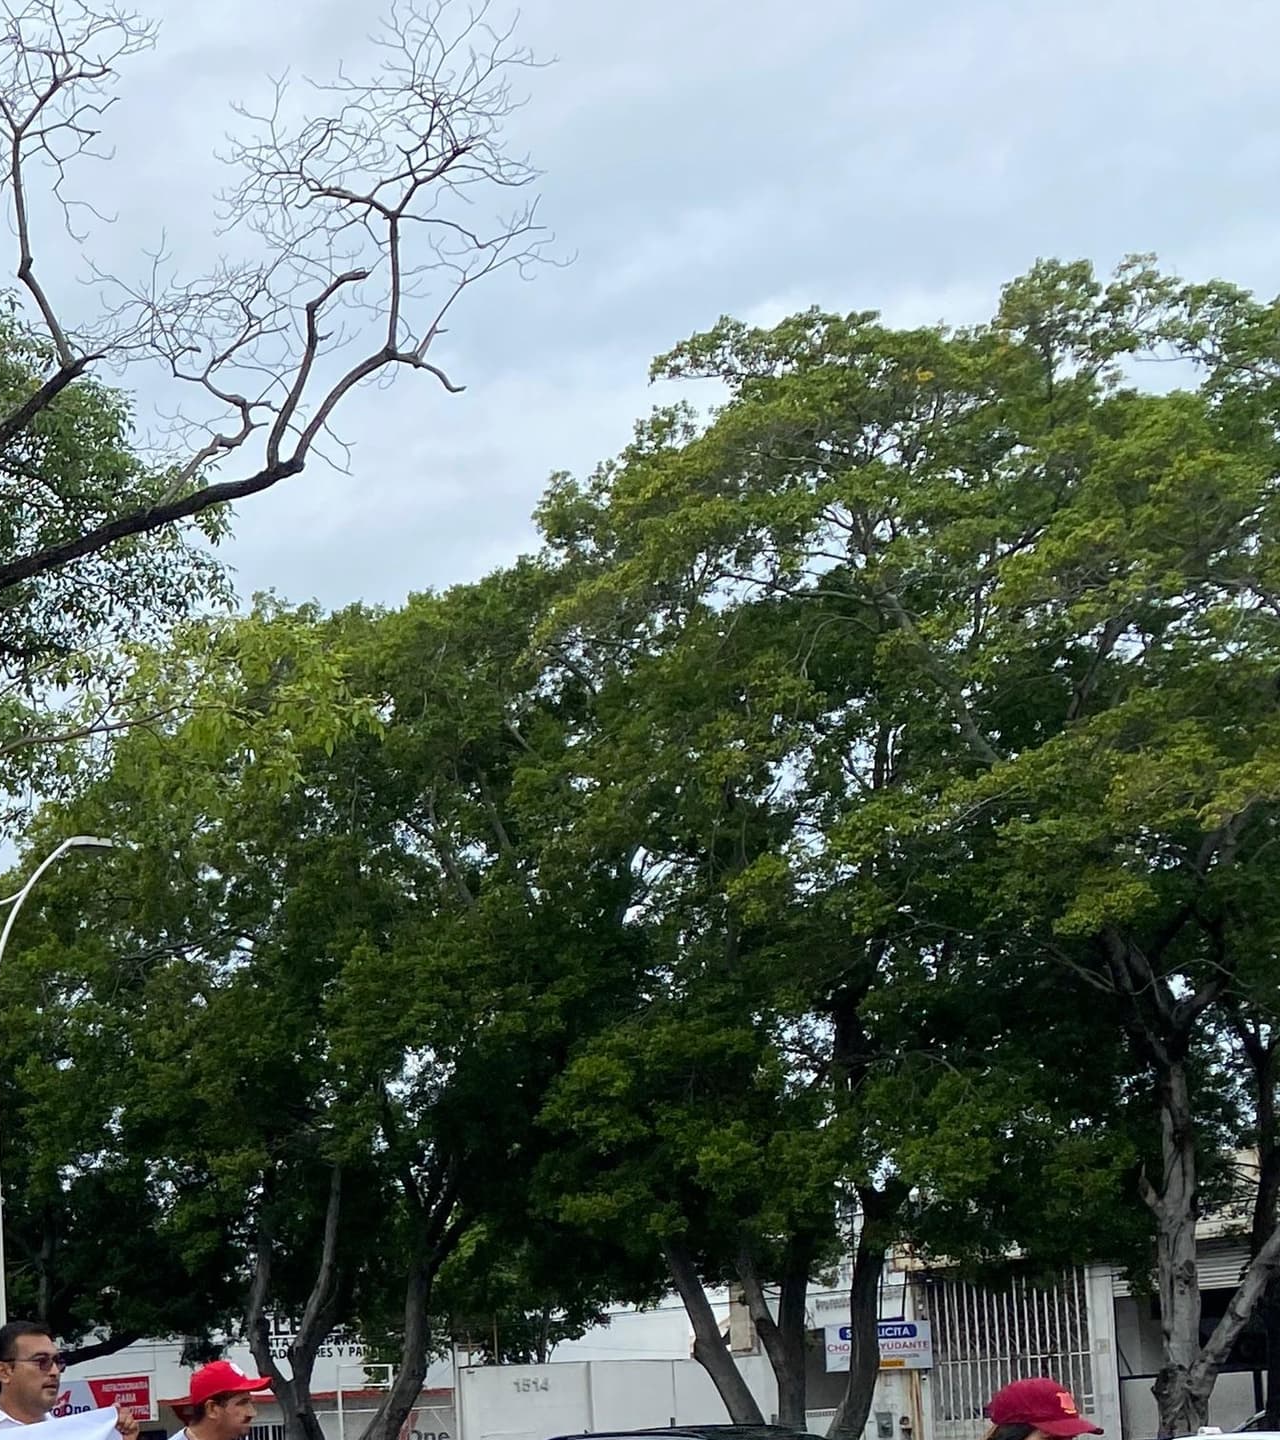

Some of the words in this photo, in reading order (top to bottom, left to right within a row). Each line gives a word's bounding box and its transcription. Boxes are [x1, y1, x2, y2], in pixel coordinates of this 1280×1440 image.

[877, 1326, 911, 1337] LICITA
[827, 1343, 850, 1353] CHO
[880, 1340, 930, 1351] YUDANTE
[513, 1377, 551, 1394] 1514
